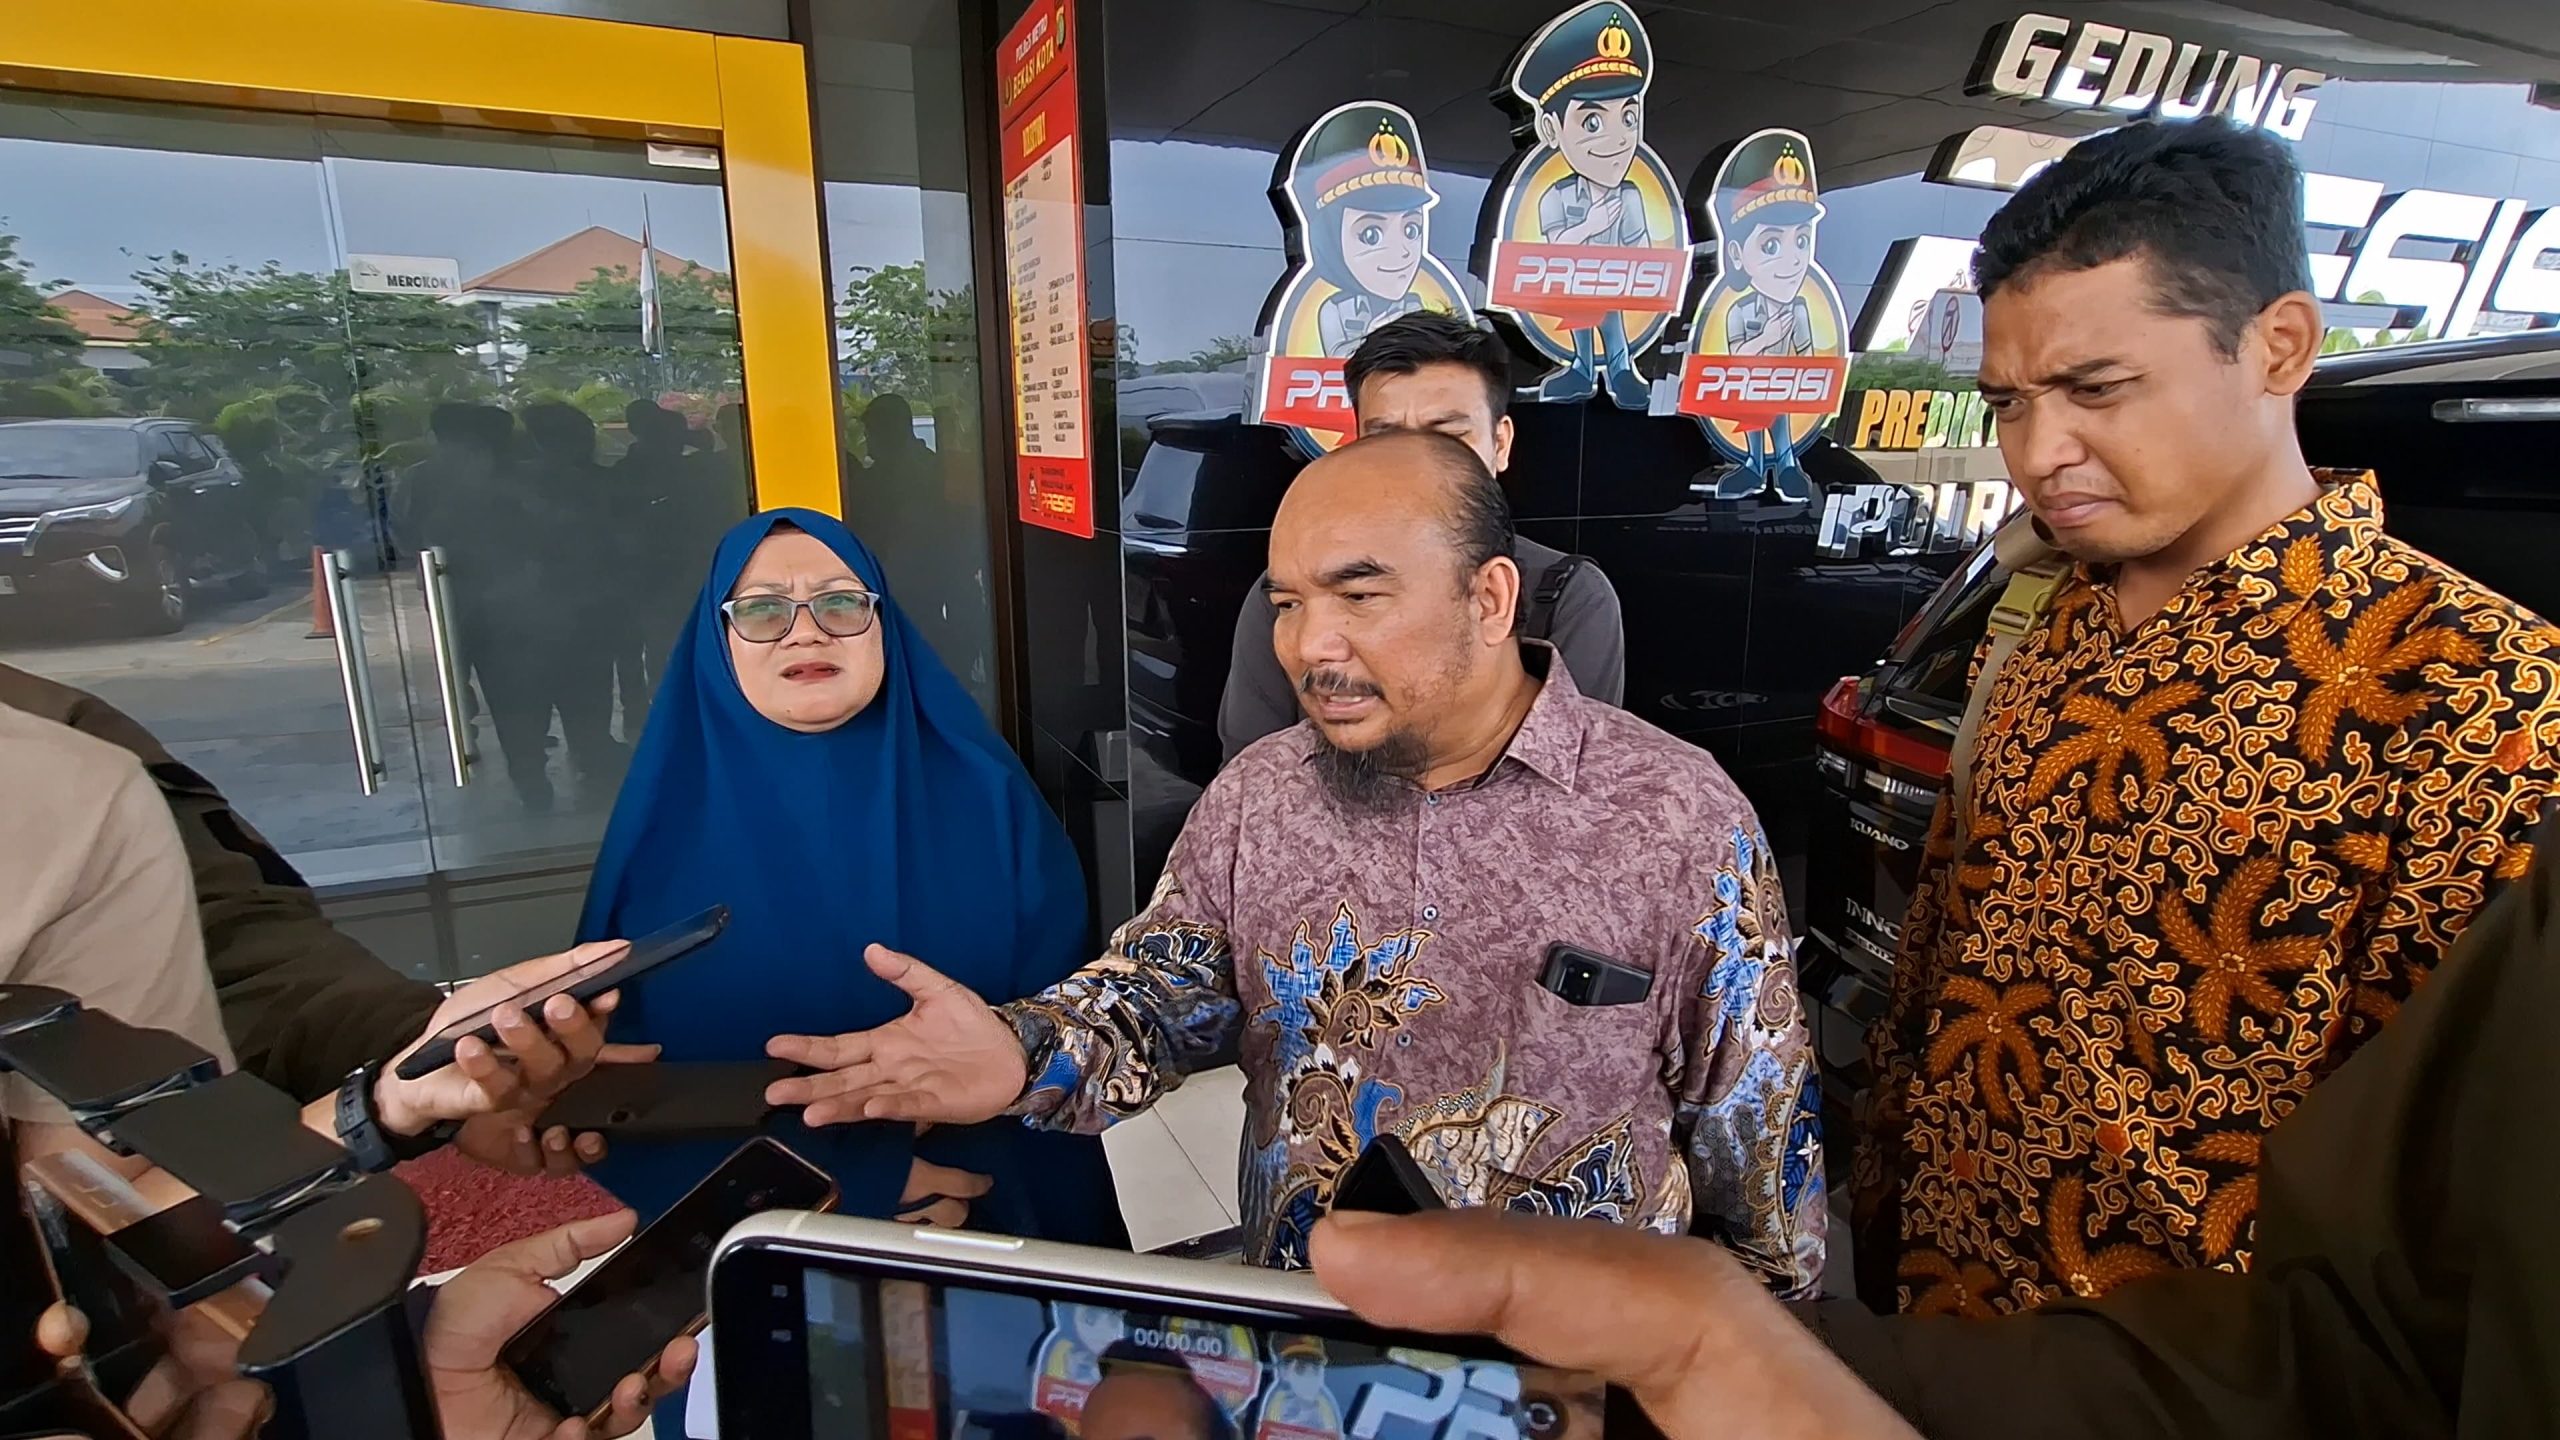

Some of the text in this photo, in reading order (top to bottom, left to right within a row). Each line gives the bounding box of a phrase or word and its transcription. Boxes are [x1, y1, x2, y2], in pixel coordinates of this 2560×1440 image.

[1013, 36, 1055, 99] BEKASI KOTA
[1992, 12, 2326, 142] GEDUNG
[387, 274, 448, 289] MEROKOK
[1513, 256, 1672, 297] PRESISI
[1696, 367, 1834, 402] PRESISI
